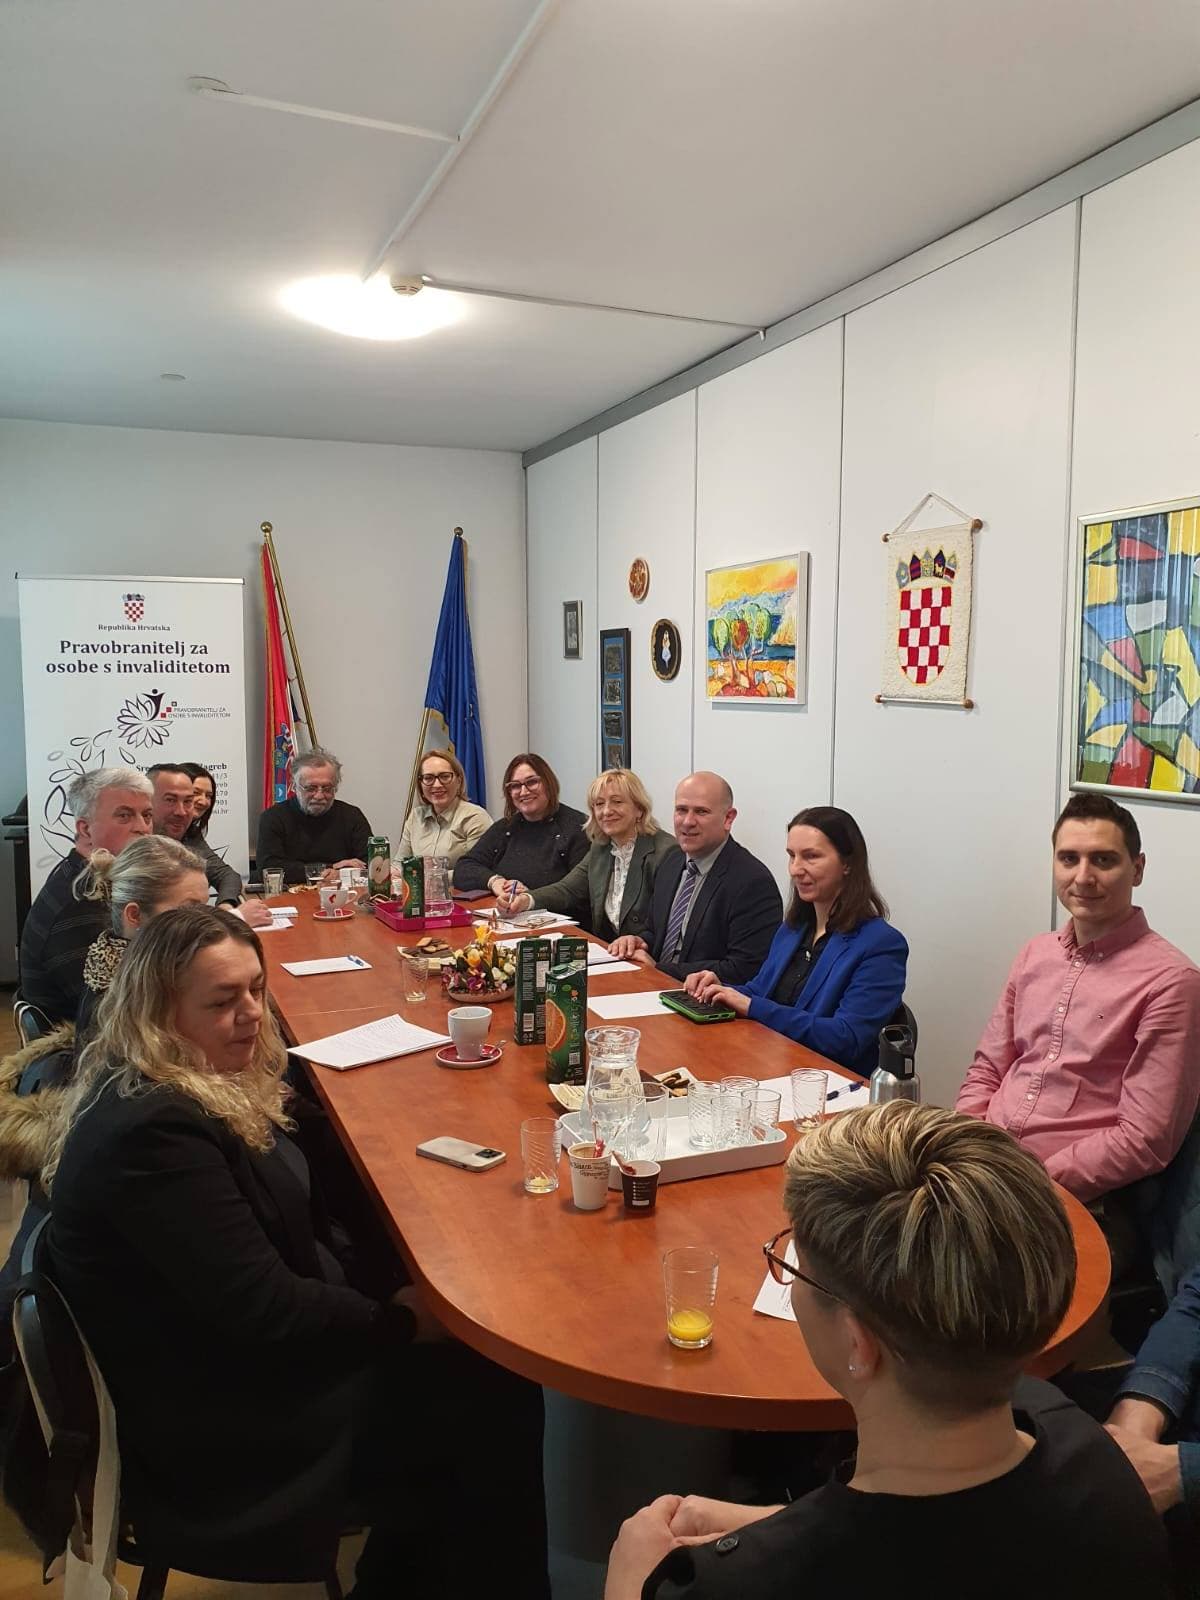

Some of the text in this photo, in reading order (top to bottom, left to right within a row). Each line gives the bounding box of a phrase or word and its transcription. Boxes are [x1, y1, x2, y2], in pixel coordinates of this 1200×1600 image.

[98, 624, 171, 632] Republika Hrvatska
[60, 640, 209, 657] Pravobranitelj za
[46, 660, 231, 674] osobe s invaliditetom
